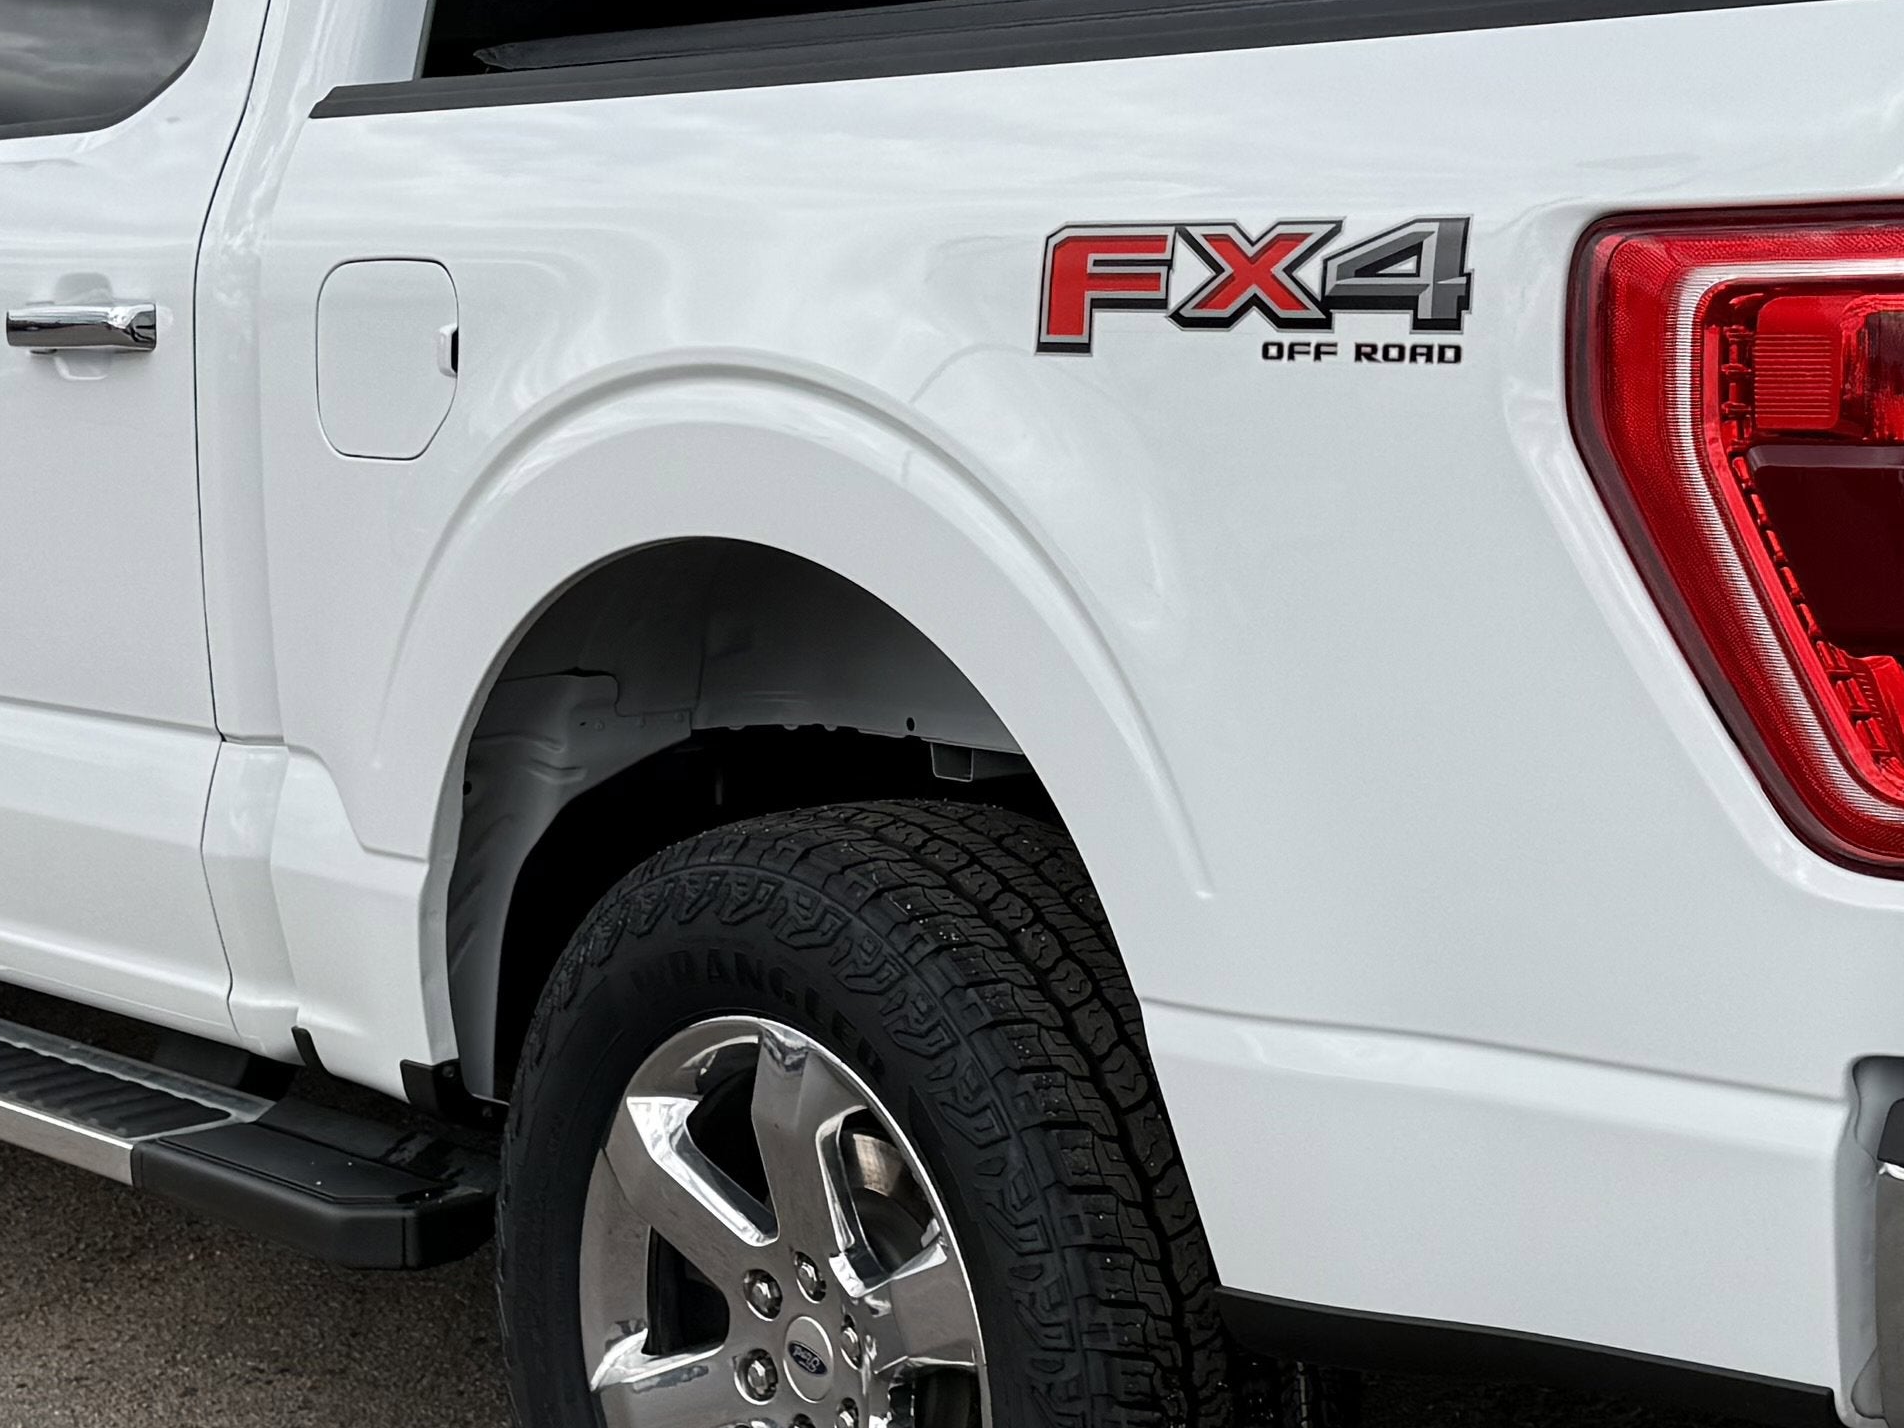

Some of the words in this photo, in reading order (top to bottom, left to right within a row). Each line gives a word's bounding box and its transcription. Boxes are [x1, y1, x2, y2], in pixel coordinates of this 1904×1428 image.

[1035, 213, 1475, 357] FX4
[1261, 339, 1339, 363] OFF
[1354, 341, 1463, 365] ROAD
